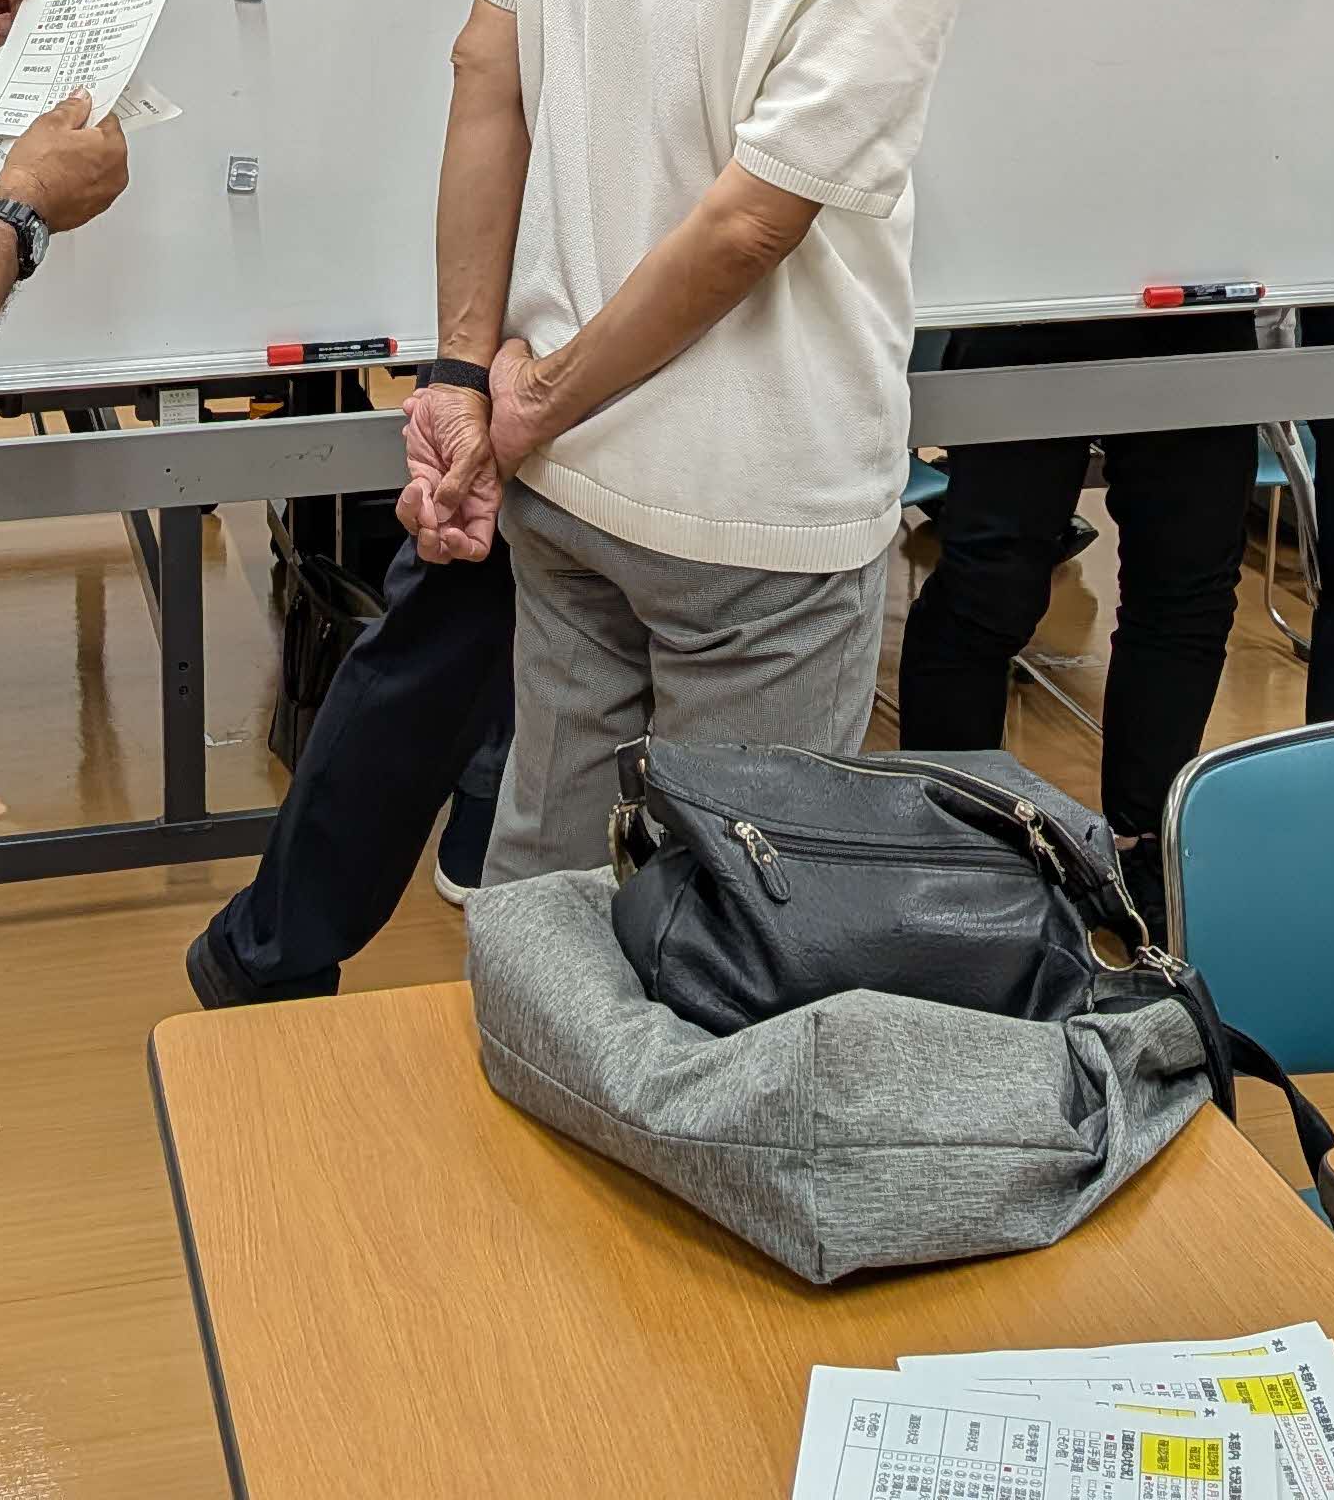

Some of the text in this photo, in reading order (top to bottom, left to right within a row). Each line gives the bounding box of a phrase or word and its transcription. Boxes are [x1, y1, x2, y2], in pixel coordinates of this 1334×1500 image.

[1012, 1433, 1025, 1450] 状況
[1070, 1438, 1085, 1473] 旧東海道
[1087, 1440, 1101, 1472] 山手通り
[1228, 1432, 1242, 1460] 本部内
[1102, 1441, 1117, 1479] 国道15号
